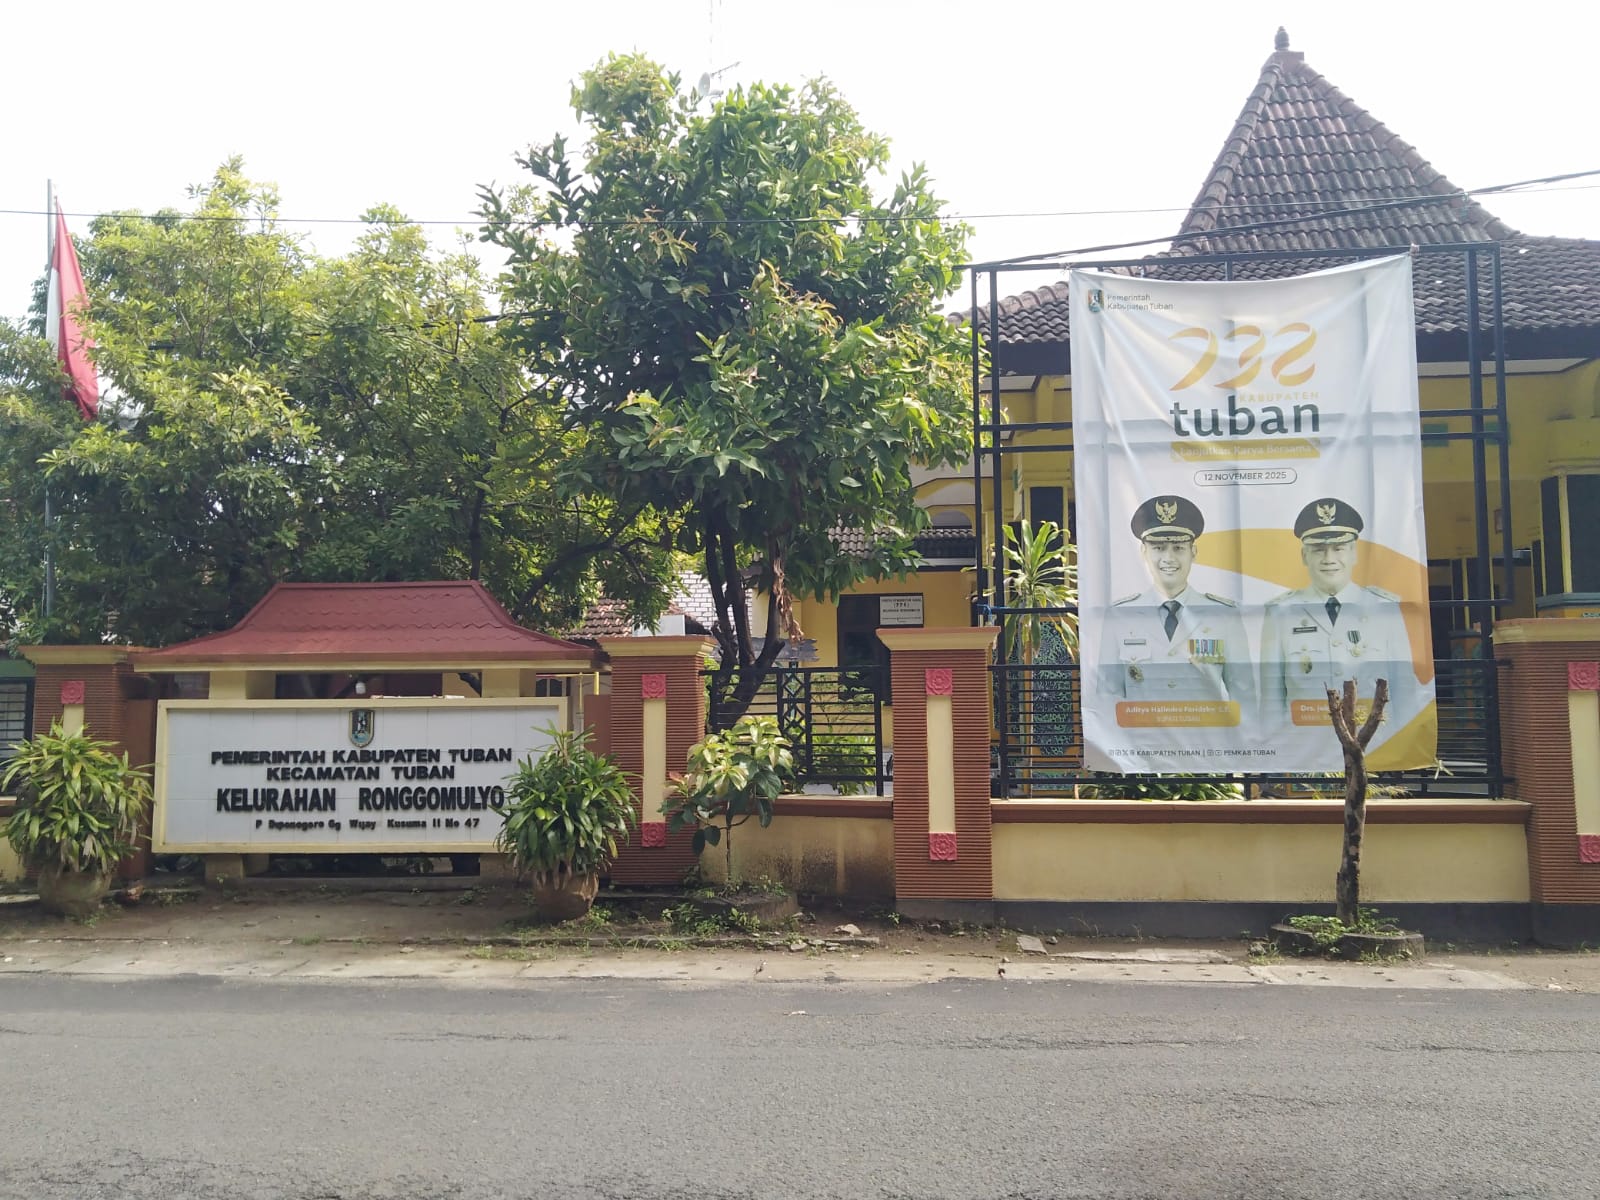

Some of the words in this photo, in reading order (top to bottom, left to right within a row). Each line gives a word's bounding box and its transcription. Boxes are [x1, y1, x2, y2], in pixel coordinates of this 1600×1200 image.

[1107, 294, 1151, 302] Pemerintah
[1107, 303, 1148, 312] Kabupaten
[1239, 391, 1319, 402] KABUPATEN
[1170, 395, 1320, 437] tuban
[1204, 473, 1213, 481] 12
[1215, 472, 1263, 480] NOVEMBER
[1265, 471, 1287, 480] 2025
[211, 750, 326, 765] PEMERINTAH
[333, 749, 441, 763] KABUPATEN
[449, 748, 512, 762] TUBAN
[267, 766, 380, 781] KECAMATAN
[392, 766, 455, 779] TUBAN
[216, 788, 336, 812] KELURAHAN
[358, 785, 505, 811] RONGGOMULYO
[328, 819, 341, 831] Gg
[387, 819, 427, 828] Kusuma
[445, 818, 460, 827] No
[464, 818, 480, 827] 47
